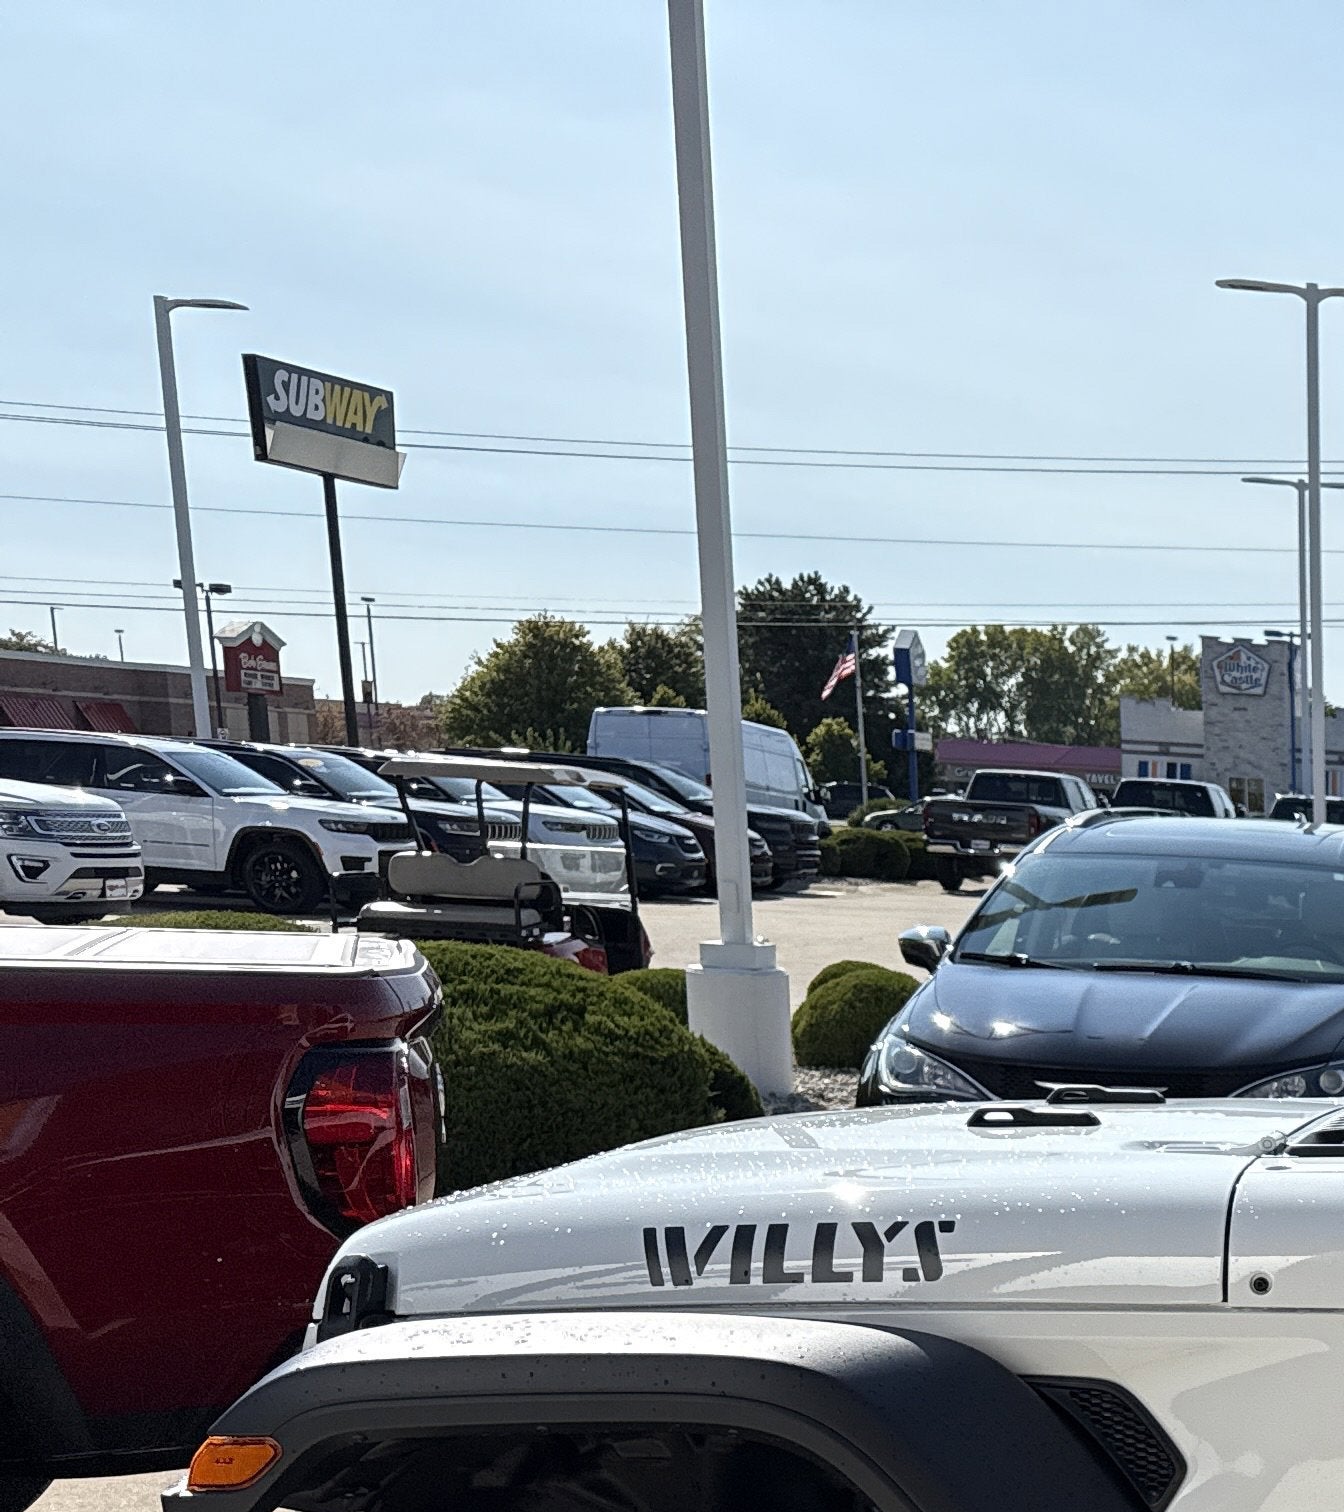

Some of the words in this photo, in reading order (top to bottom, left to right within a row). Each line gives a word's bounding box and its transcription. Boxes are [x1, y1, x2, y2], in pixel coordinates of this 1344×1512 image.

[266, 369, 388, 434] SUBWAY
[1221, 673, 1262, 687] Castle
[1224, 661, 1260, 674] White
[643, 1221, 956, 1287] WILLYS
